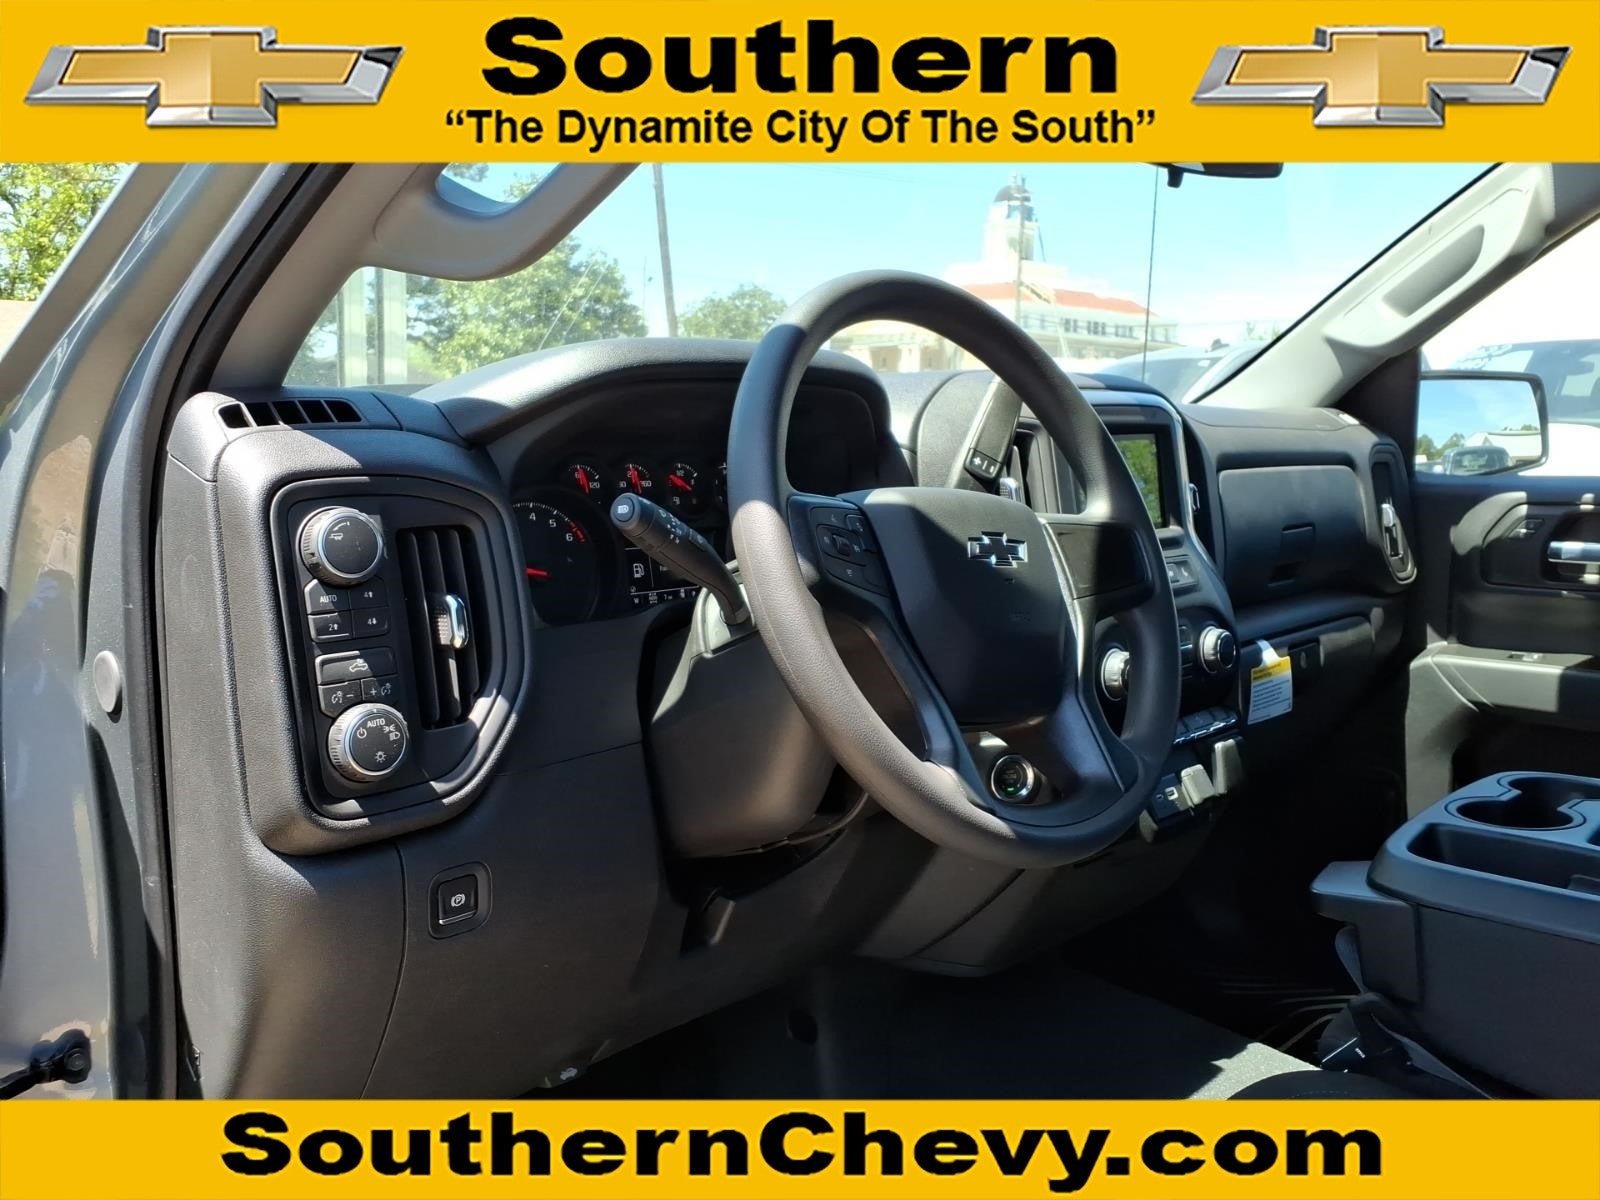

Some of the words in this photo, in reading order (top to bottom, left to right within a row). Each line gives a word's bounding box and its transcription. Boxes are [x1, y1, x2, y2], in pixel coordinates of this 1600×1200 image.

[529, 512, 536, 521] 4
[549, 519, 557, 528] 5
[566, 533, 573, 542] 6
[366, 718, 386, 728] AUTO
